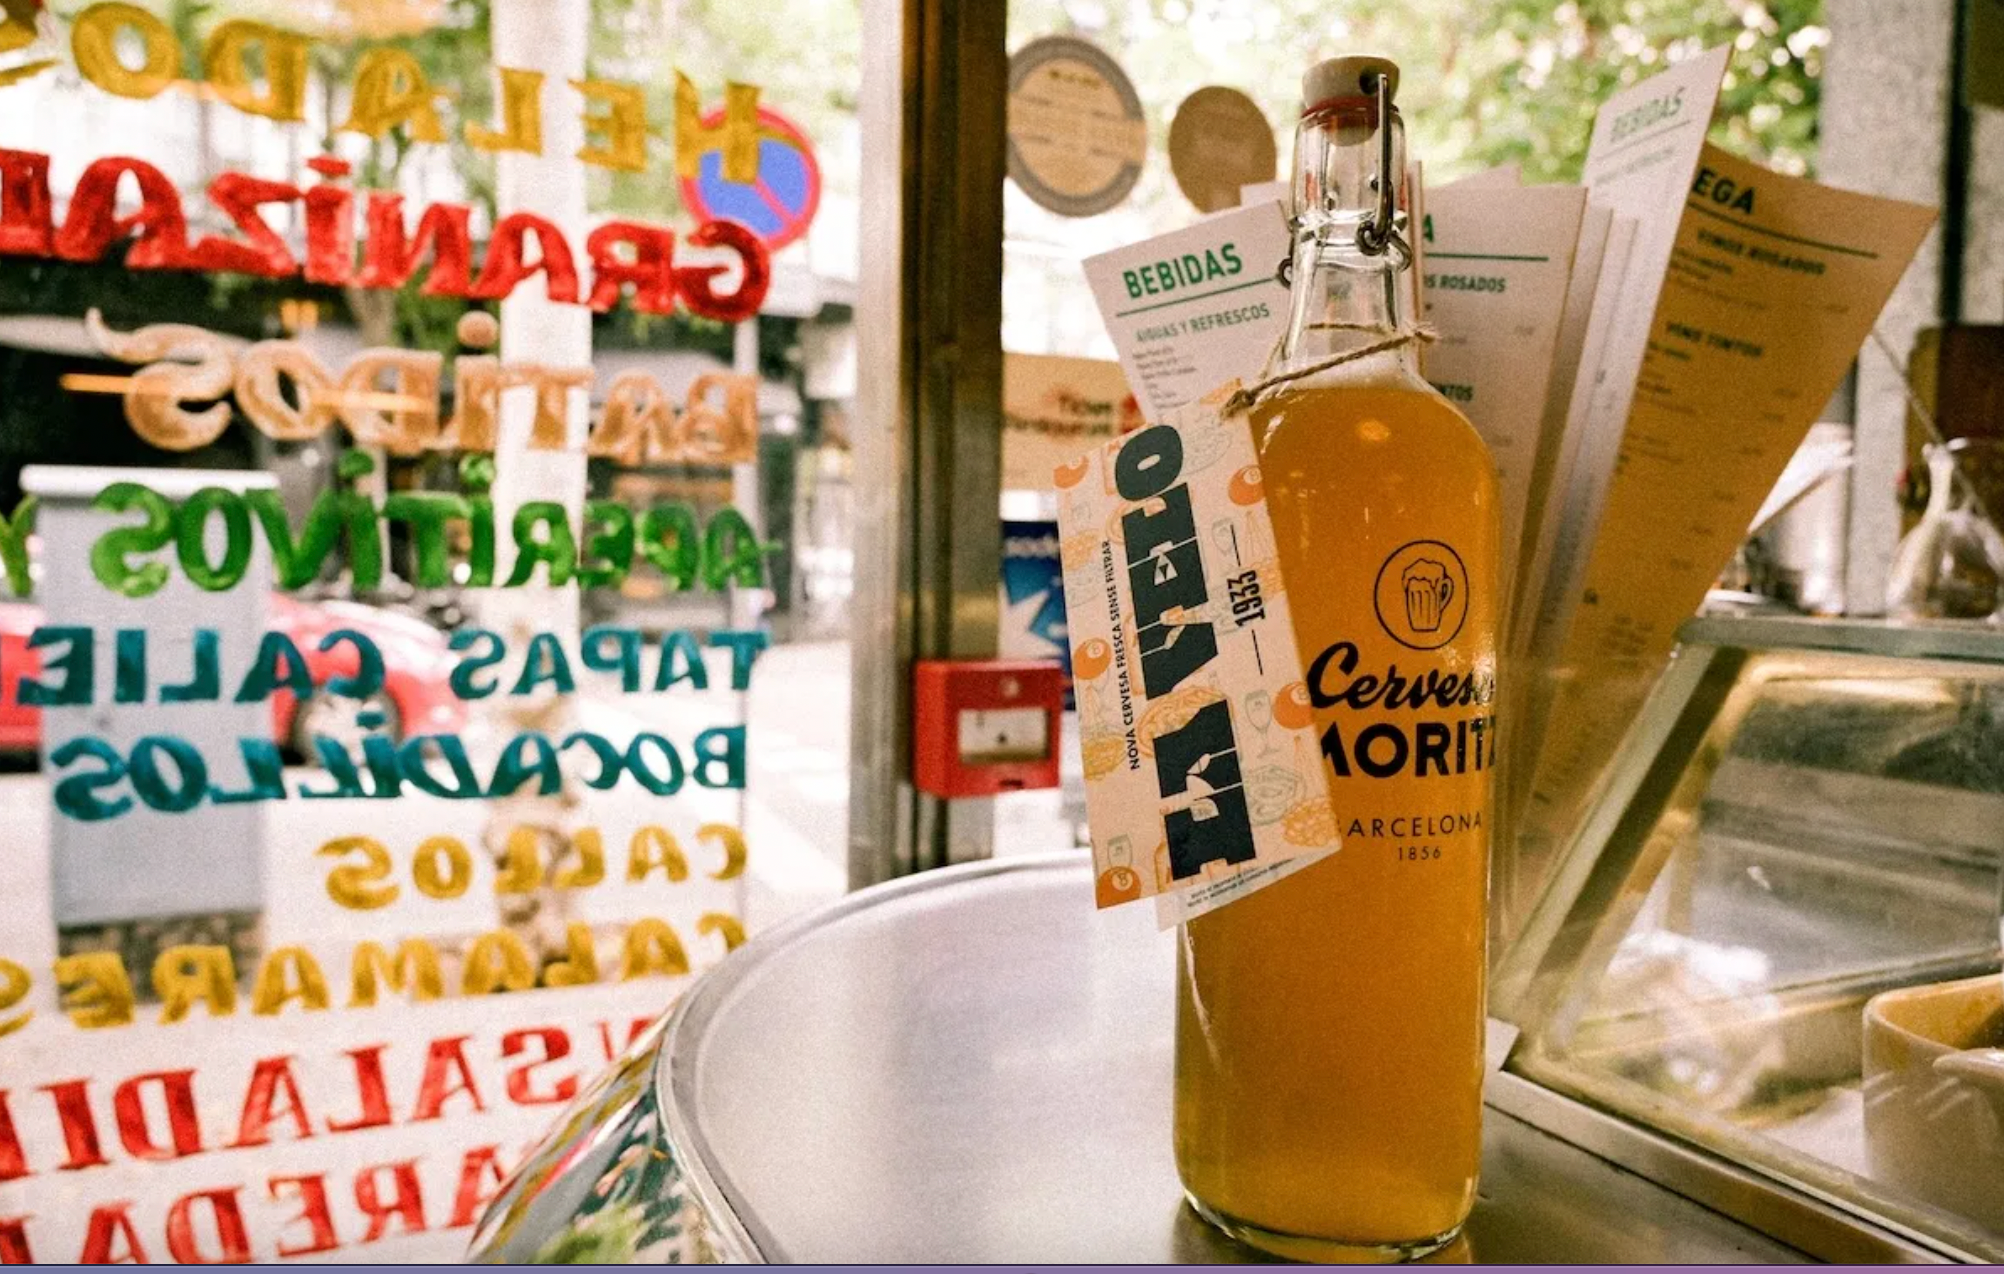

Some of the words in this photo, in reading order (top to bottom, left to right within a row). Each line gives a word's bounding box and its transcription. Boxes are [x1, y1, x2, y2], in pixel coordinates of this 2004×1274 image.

[1122, 243, 1243, 299] BEBIDAS
[1440, 274, 1507, 294] ROSADOS
[1189, 302, 1270, 333] REFRESCOS
[1102, 540, 1116, 585] FILTRAR
[1115, 425, 1220, 700] VELO
[1107, 585, 1121, 621] SENSE
[1227, 569, 1266, 627] 1933
[1111, 624, 1127, 669] FRESCA
[1117, 670, 1134, 726] CERVESA
[1307, 641, 1495, 710] Cerves
[1125, 728, 1140, 771] NOVA
[1153, 699, 1256, 881] LA
[1340, 811, 1483, 839] ARCELONA
[1398, 845, 1442, 861] 1856
